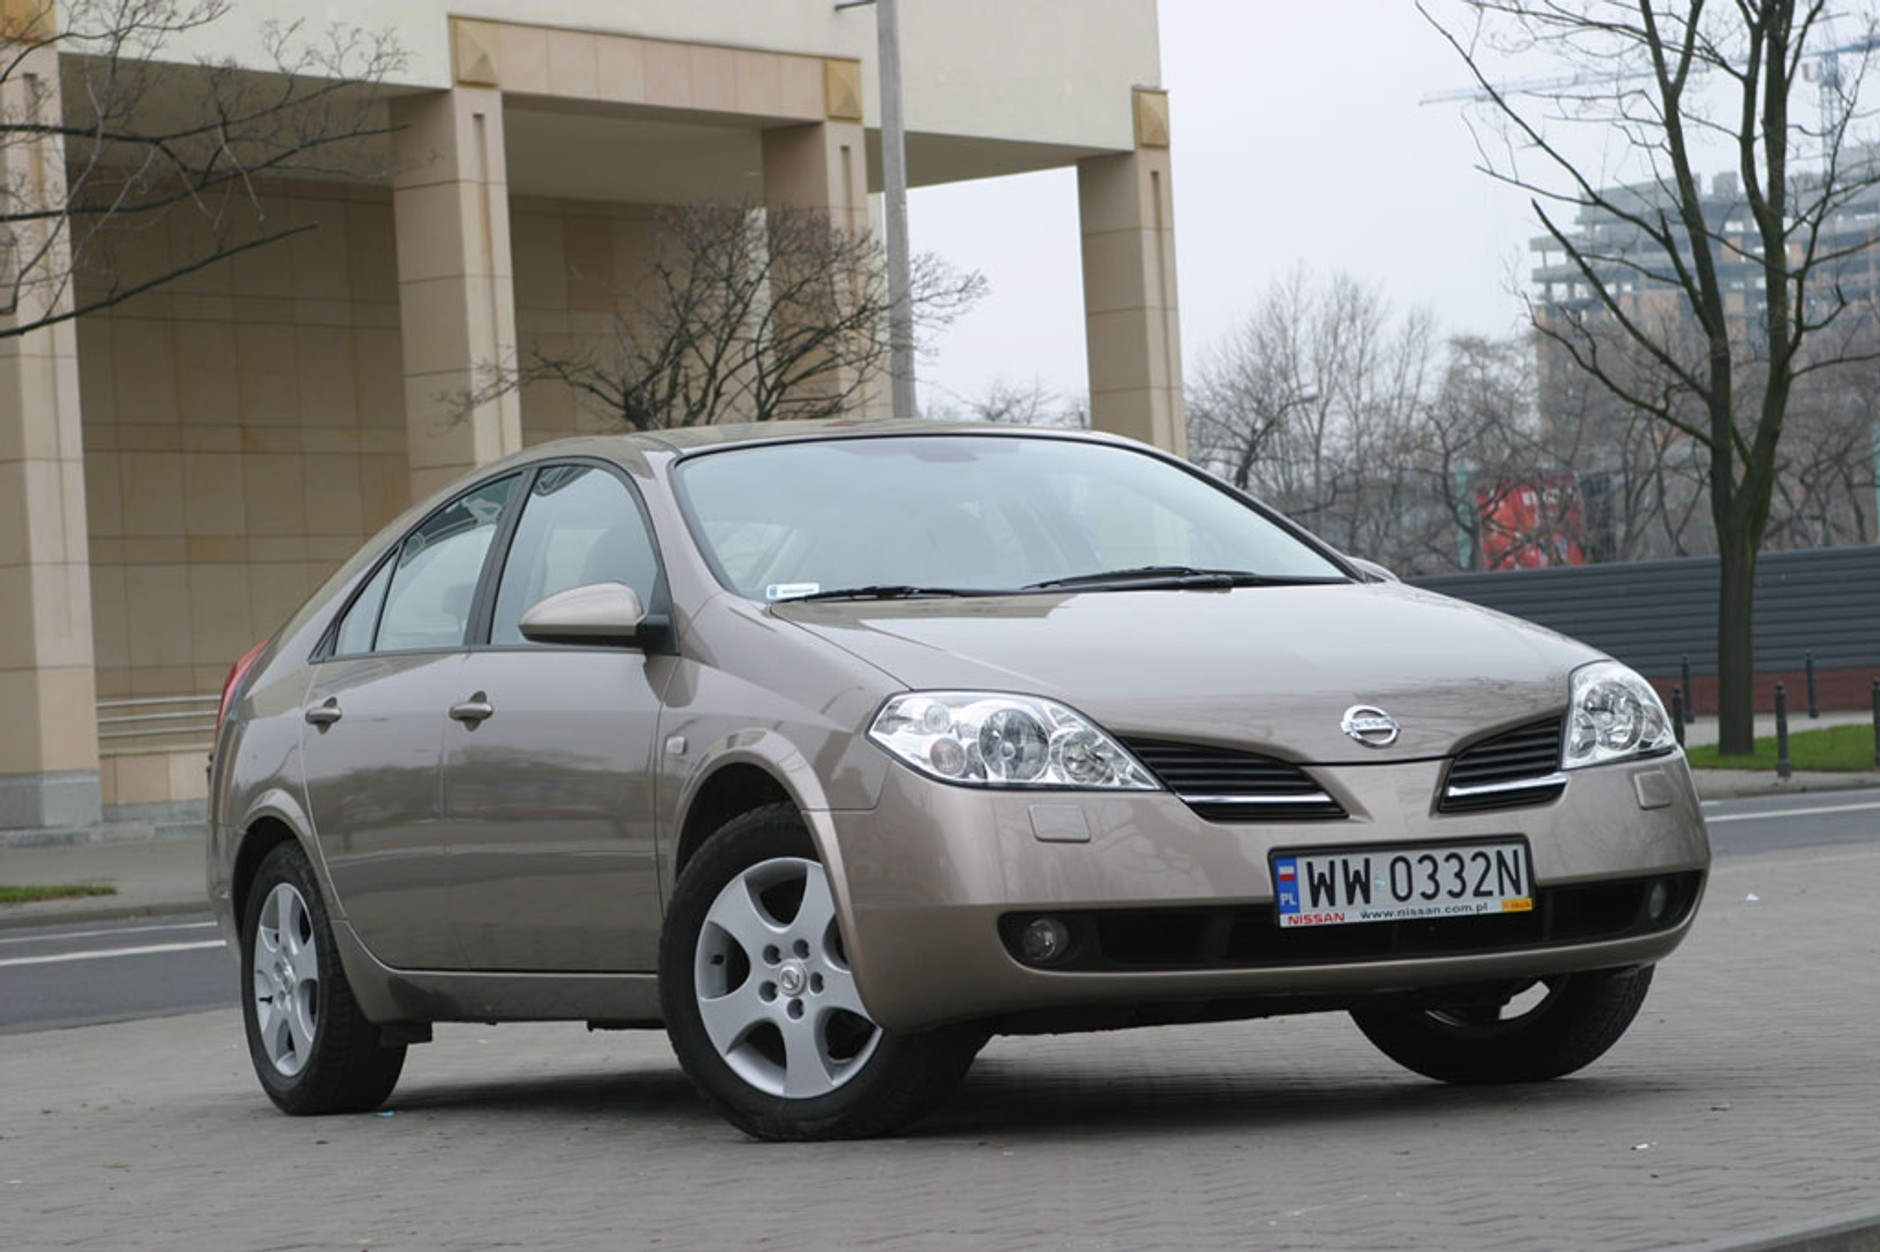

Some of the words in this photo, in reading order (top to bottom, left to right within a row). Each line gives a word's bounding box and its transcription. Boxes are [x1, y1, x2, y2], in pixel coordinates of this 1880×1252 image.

[1306, 858, 1370, 908] WW
[1389, 849, 1523, 902] 0332N
[1280, 893, 1297, 906] PL
[1360, 902, 1488, 919] www.nissan.com.pl
[1287, 912, 1345, 925] NISSAN
